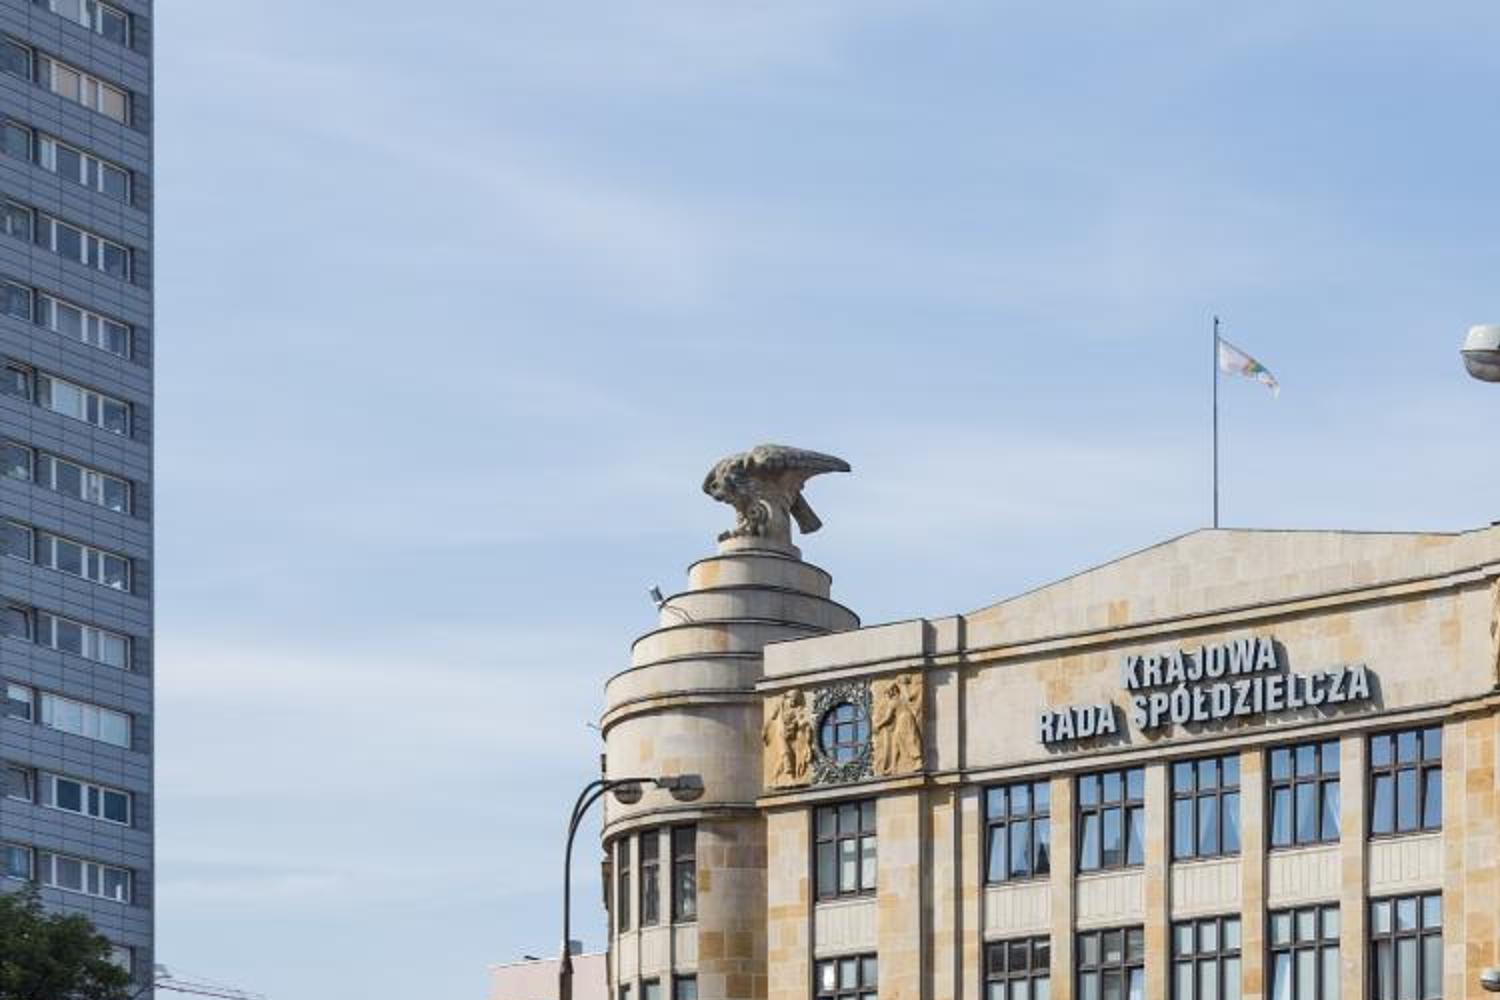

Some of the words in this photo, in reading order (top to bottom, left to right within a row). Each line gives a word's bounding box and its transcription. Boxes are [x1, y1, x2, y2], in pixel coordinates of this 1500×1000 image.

[1119, 637, 1277, 690] KRAJOWA
[1040, 703, 1117, 743] RADA
[1134, 664, 1370, 731] SPÓŁDZIELCZA
